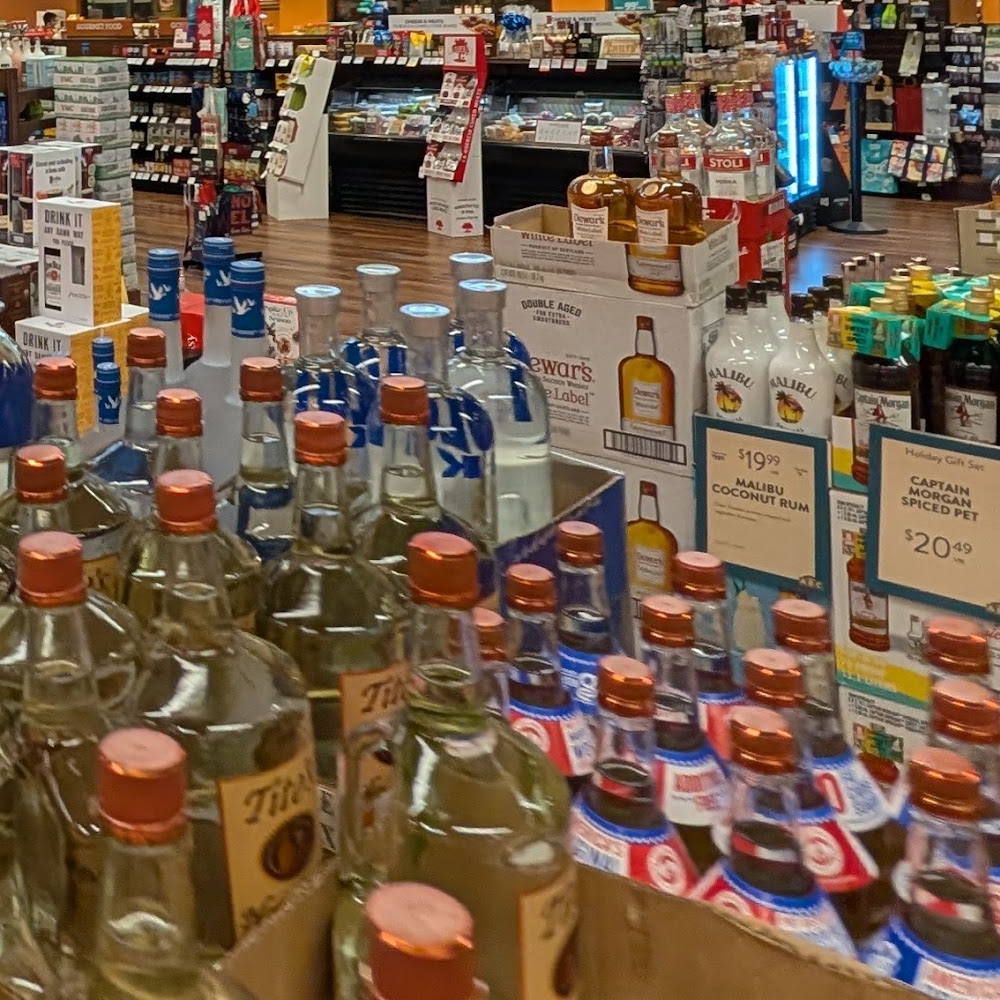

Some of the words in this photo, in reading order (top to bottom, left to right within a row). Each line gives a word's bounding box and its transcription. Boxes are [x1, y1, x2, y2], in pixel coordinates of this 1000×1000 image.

[105, 22, 123, 30] FOOD
[708, 157, 744, 169] STOLI
[44, 208, 71, 228] DRINK
[74, 212, 84, 228] IT
[573, 213, 605, 225] Dewar's
[73, 230, 84, 240] WAY
[520, 298, 555, 310] DOUBLE
[557, 301, 582, 317] AGED
[22, 330, 50, 351] DRINK
[52, 338, 62, 352] IT
[530, 356, 593, 383] ewar's
[708, 367, 756, 389] MALIBU
[769, 375, 819, 400] MALIBU
[880, 395, 910, 410] Morgan
[964, 394, 996, 409] Morgan
[904, 447, 942, 465] Holiday
[945, 456, 966, 468] Gift
[967, 460, 986, 472] Set
[735, 477, 784, 497] MALIBU
[910, 475, 970, 497] CAPTAIN
[712, 483, 777, 506] COCONUT
[779, 498, 811, 513] RUM
[908, 486, 972, 509] MORGAN
[901, 496, 951, 516] SPICED
[953, 507, 980, 523] PET
